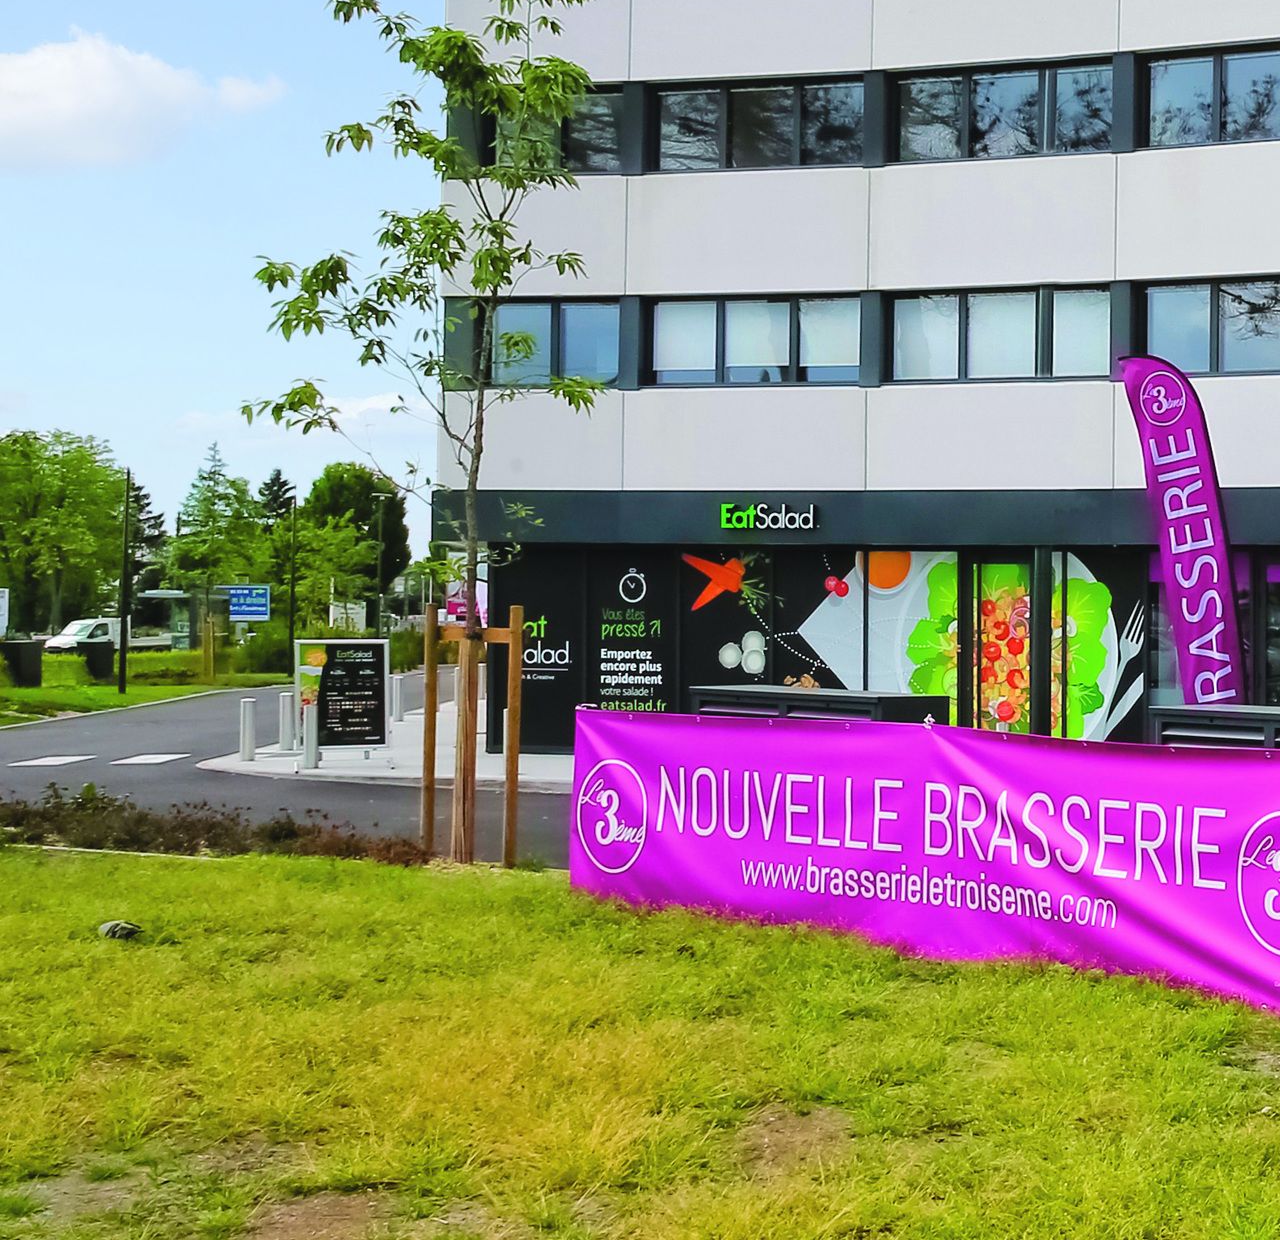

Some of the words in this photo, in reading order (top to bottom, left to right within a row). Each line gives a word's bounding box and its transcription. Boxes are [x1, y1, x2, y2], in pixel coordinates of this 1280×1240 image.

[1149, 428, 1238, 704] RASSERIE
[602, 608, 623, 620] Vous
[625, 608, 645, 620] êtes
[522, 615, 548, 638] at
[601, 622, 646, 640] pressé
[522, 640, 569, 664] alad
[600, 648, 652, 663] Emportez
[600, 662, 637, 672] encore
[639, 661, 662, 674] plus
[600, 674, 663, 686] rapidement
[600, 687, 621, 696] votre
[622, 686, 649, 697] salade
[600, 698, 667, 711] eatsalad.fr
[595, 789, 645, 845] 3ème
[655, 765, 904, 853] NOUVELLE
[923, 781, 1227, 891] BRASSERIE
[741, 856, 1117, 930] www.brasserieletroiseme.com
